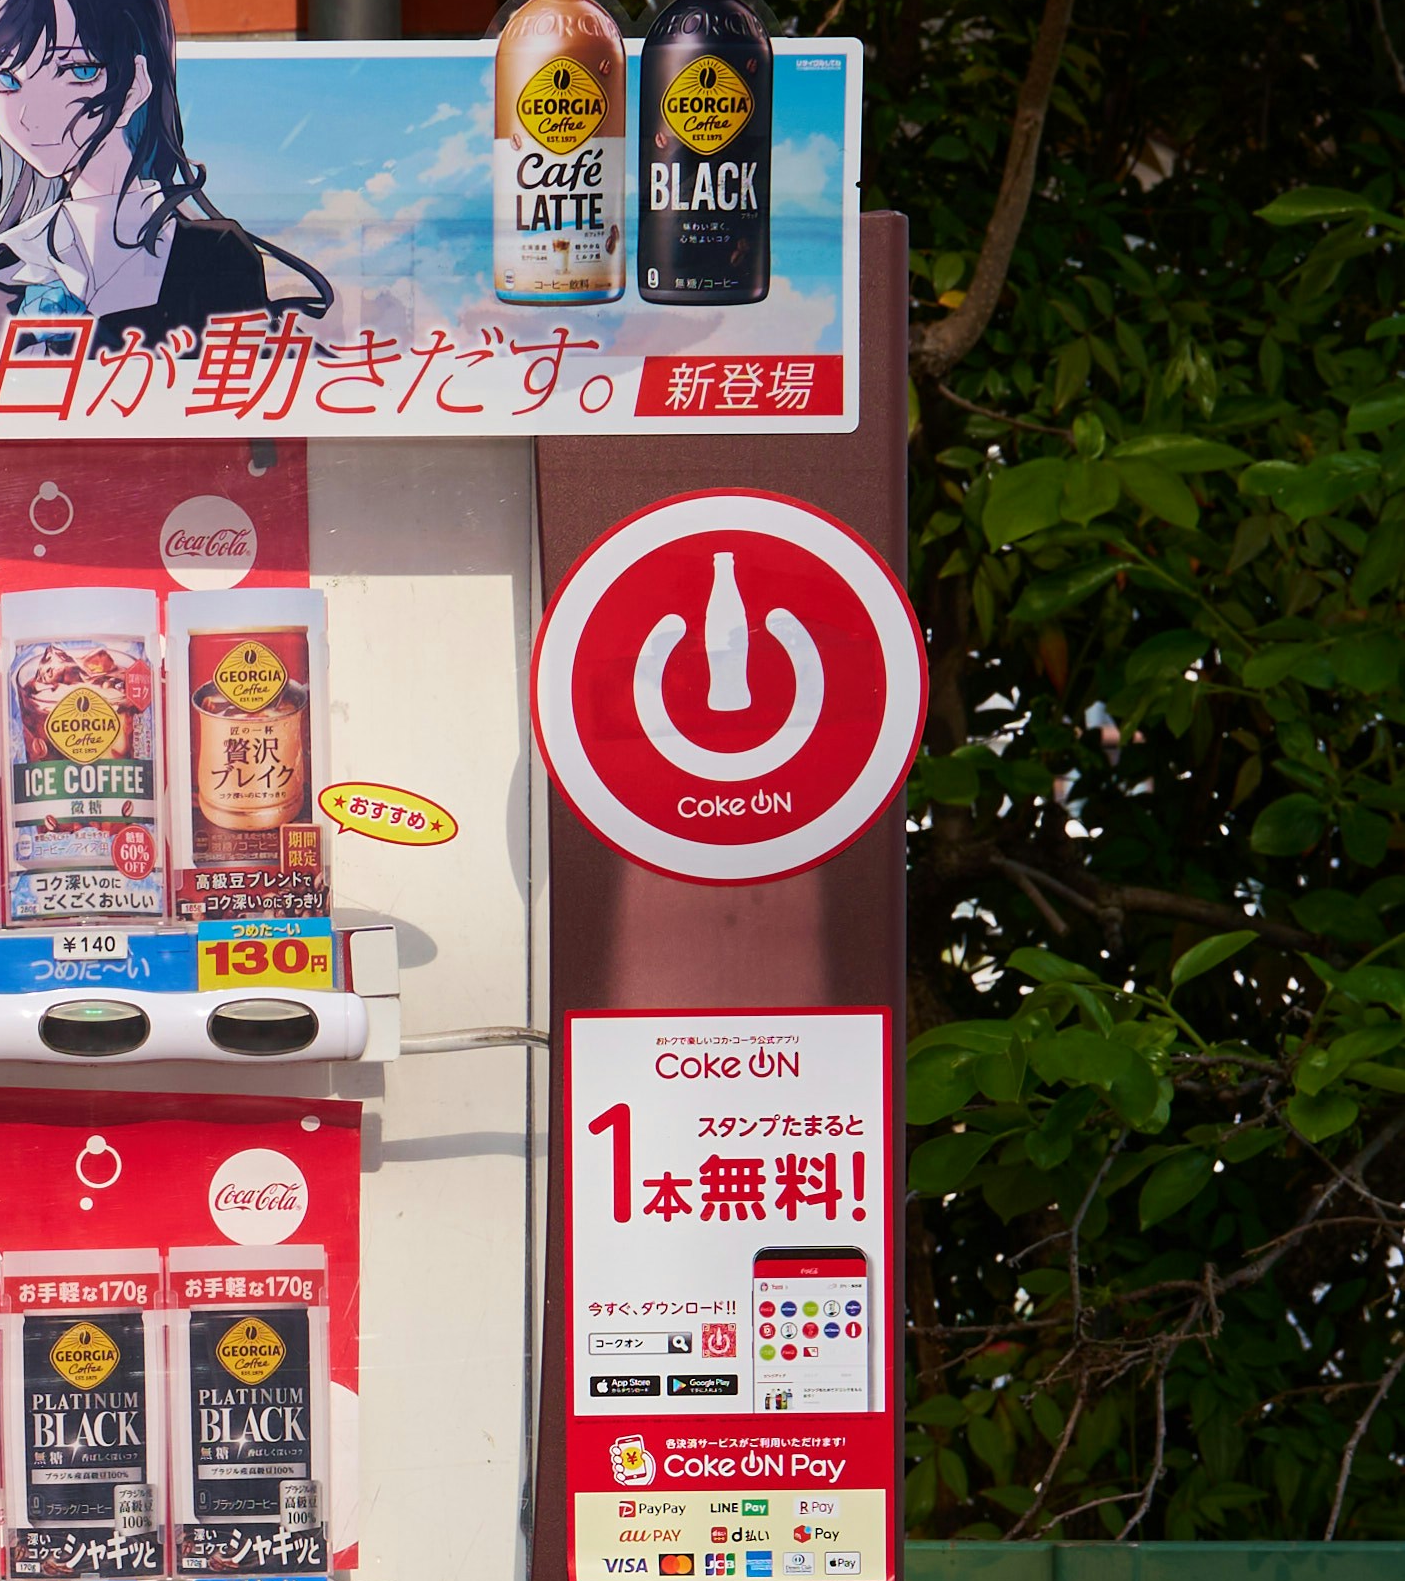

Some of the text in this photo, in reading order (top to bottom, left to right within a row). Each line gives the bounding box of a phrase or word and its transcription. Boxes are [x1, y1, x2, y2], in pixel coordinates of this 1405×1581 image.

[521, 98, 605, 116] GEORGIA
[517, 151, 603, 192] Café
[649, 162, 758, 212] BLACK
[517, 192, 605, 232] LATTE
[664, 361, 816, 411] 新登場
[25, 765, 144, 794] ICE COFFEE
[349, 797, 427, 828] おすすめ
[677, 788, 791, 818] Coke ON
[43, 894, 155, 910] ごくごくおいしい
[204, 941, 327, 974] 130円
[655, 1047, 799, 1080] Coke ON
[698, 1114, 864, 1138] スタンプたまると
[589, 1103, 866, 1223] 1本無料!
[589, 1300, 736, 1316] 今すぐ、ダウンロード!!
[594, 1338, 643, 1348] コークオン
[612, 1379, 626, 1387] App
[690, 1379, 729, 1387] Google Play
[33, 1392, 138, 1410] PLATINUM
[33, 1412, 141, 1448] BLACK
[666, 1438, 846, 1448] 各決済サービスがご利用いただけます!
[664, 1450, 846, 1483] Coke ON Pay
[639, 1503, 686, 1515] PayPay
[711, 1503, 766, 1513] LINE Pay
[602, 1558, 648, 1573] VISA
